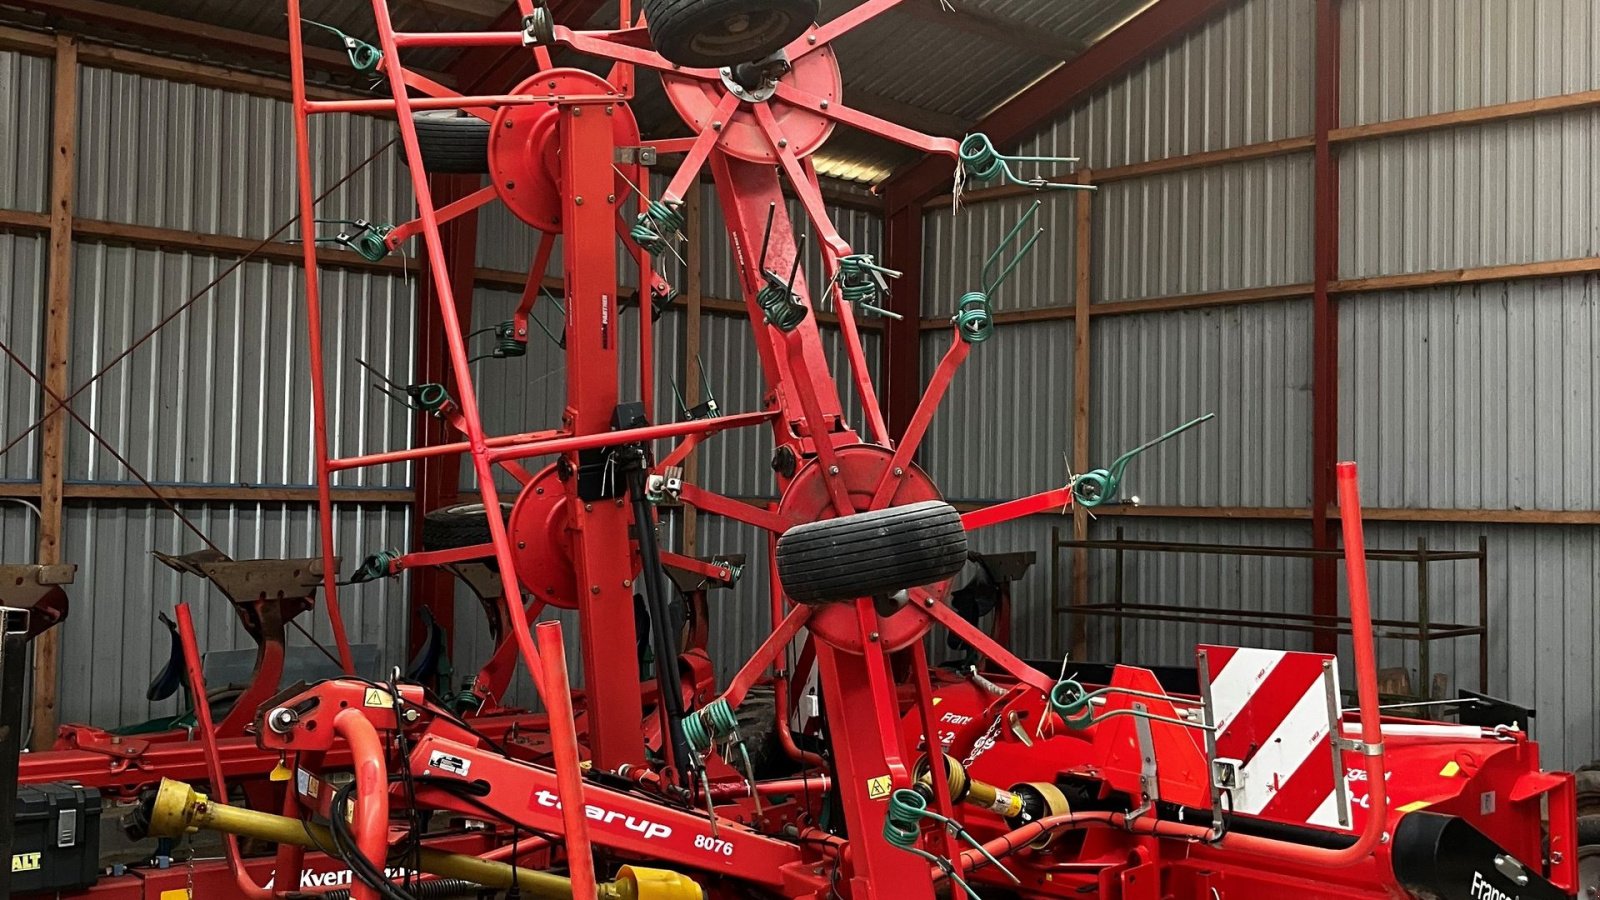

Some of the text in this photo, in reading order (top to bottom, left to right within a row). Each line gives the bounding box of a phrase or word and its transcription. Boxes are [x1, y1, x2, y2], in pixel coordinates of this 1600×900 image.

[534, 789, 733, 856] tarup 8076
[11, 852, 41, 872] ALT
[1470, 870, 1520, 900] Fran
